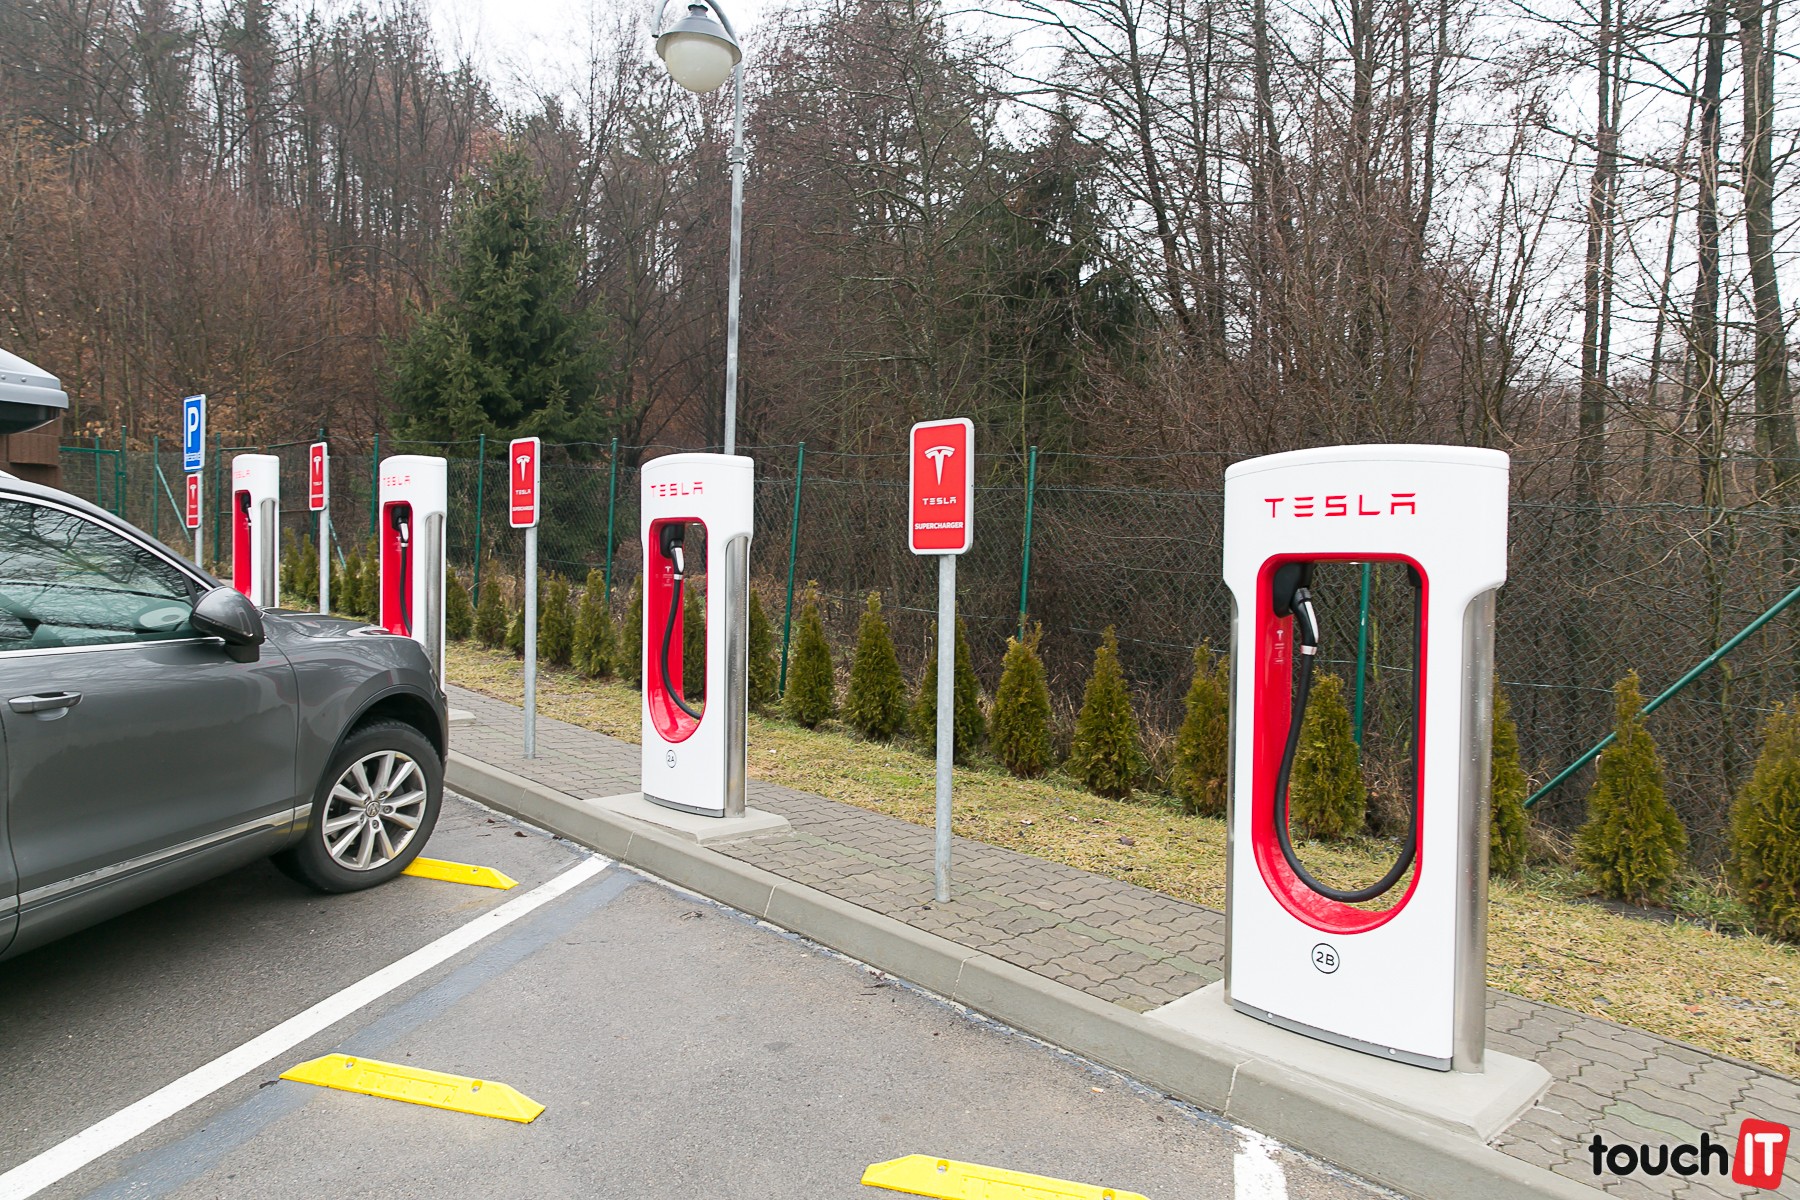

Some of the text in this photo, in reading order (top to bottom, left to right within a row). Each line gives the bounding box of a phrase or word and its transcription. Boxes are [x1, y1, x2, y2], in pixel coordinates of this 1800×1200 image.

[187, 406, 200, 448] P
[650, 481, 704, 498] TESLA
[922, 496, 957, 505] TESLA
[1264, 493, 1416, 518] TESLA
[915, 522, 963, 530] SUPERCHARGER
[1316, 951, 1335, 966] 2B
